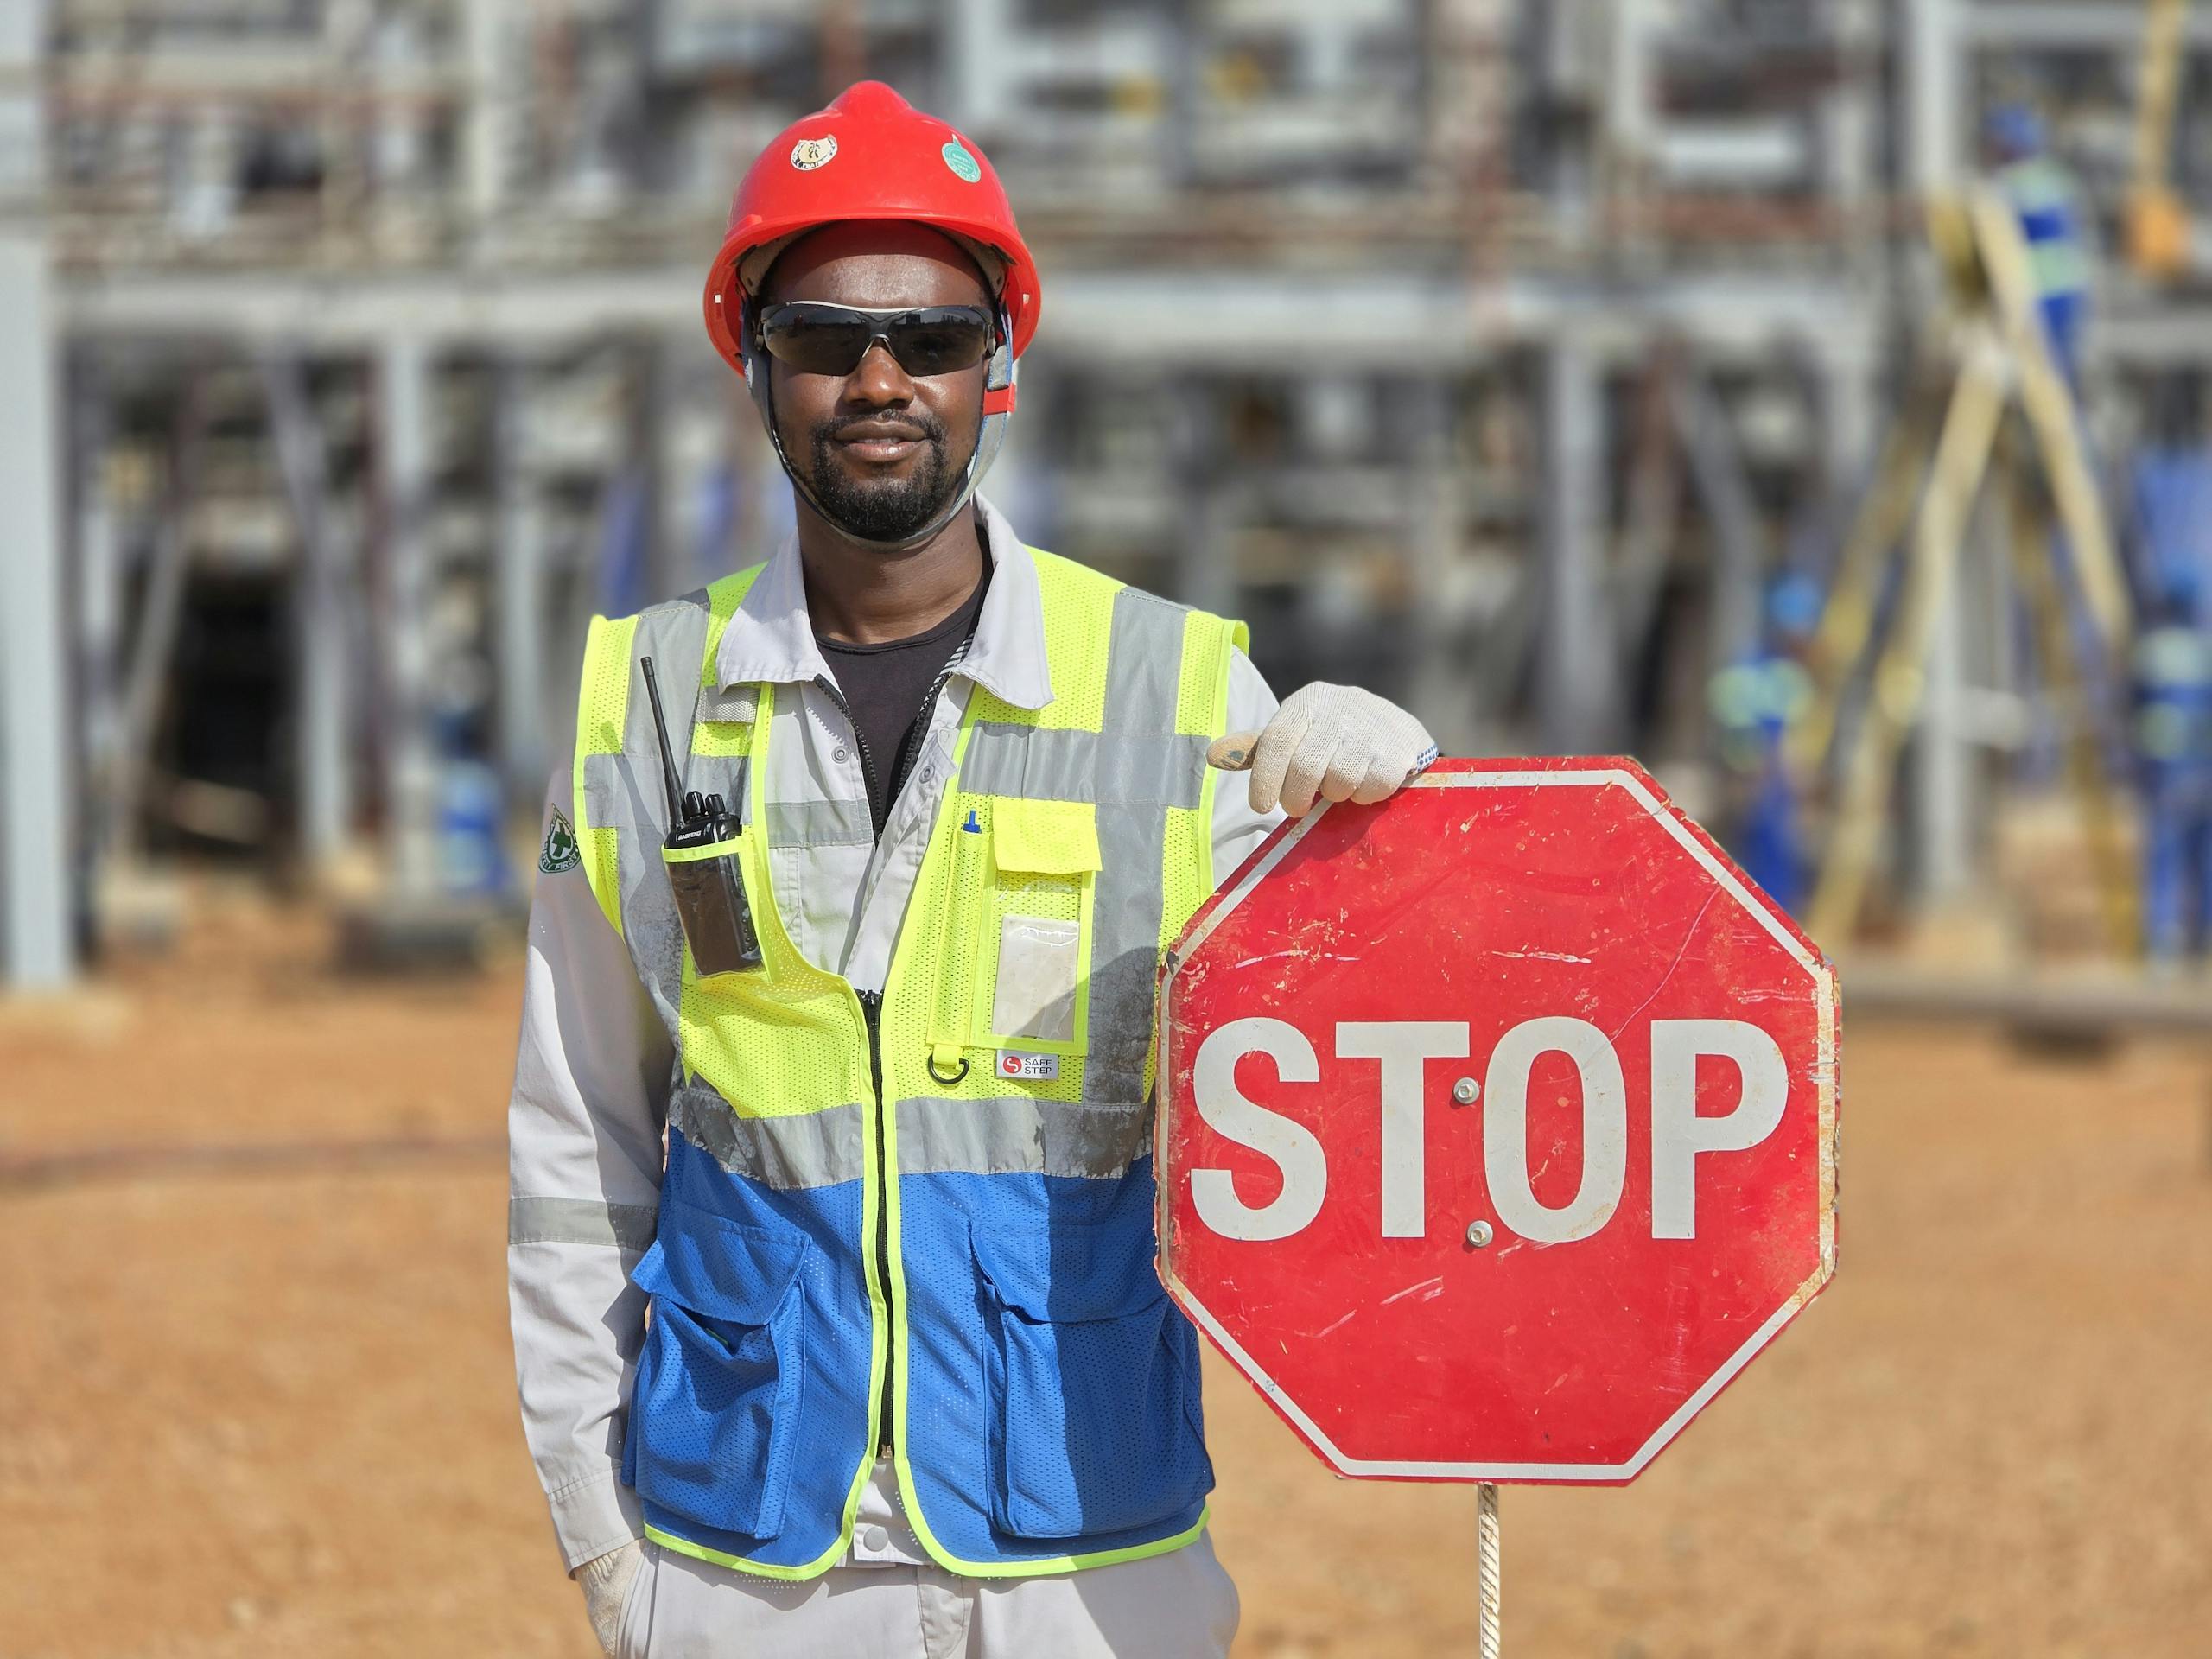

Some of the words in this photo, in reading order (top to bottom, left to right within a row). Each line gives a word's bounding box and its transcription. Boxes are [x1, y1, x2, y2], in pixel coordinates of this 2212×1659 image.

[677, 830, 702, 841] BAOFENG
[555, 852, 577, 870] FIRST
[1190, 1016, 1789, 1243] STOP
